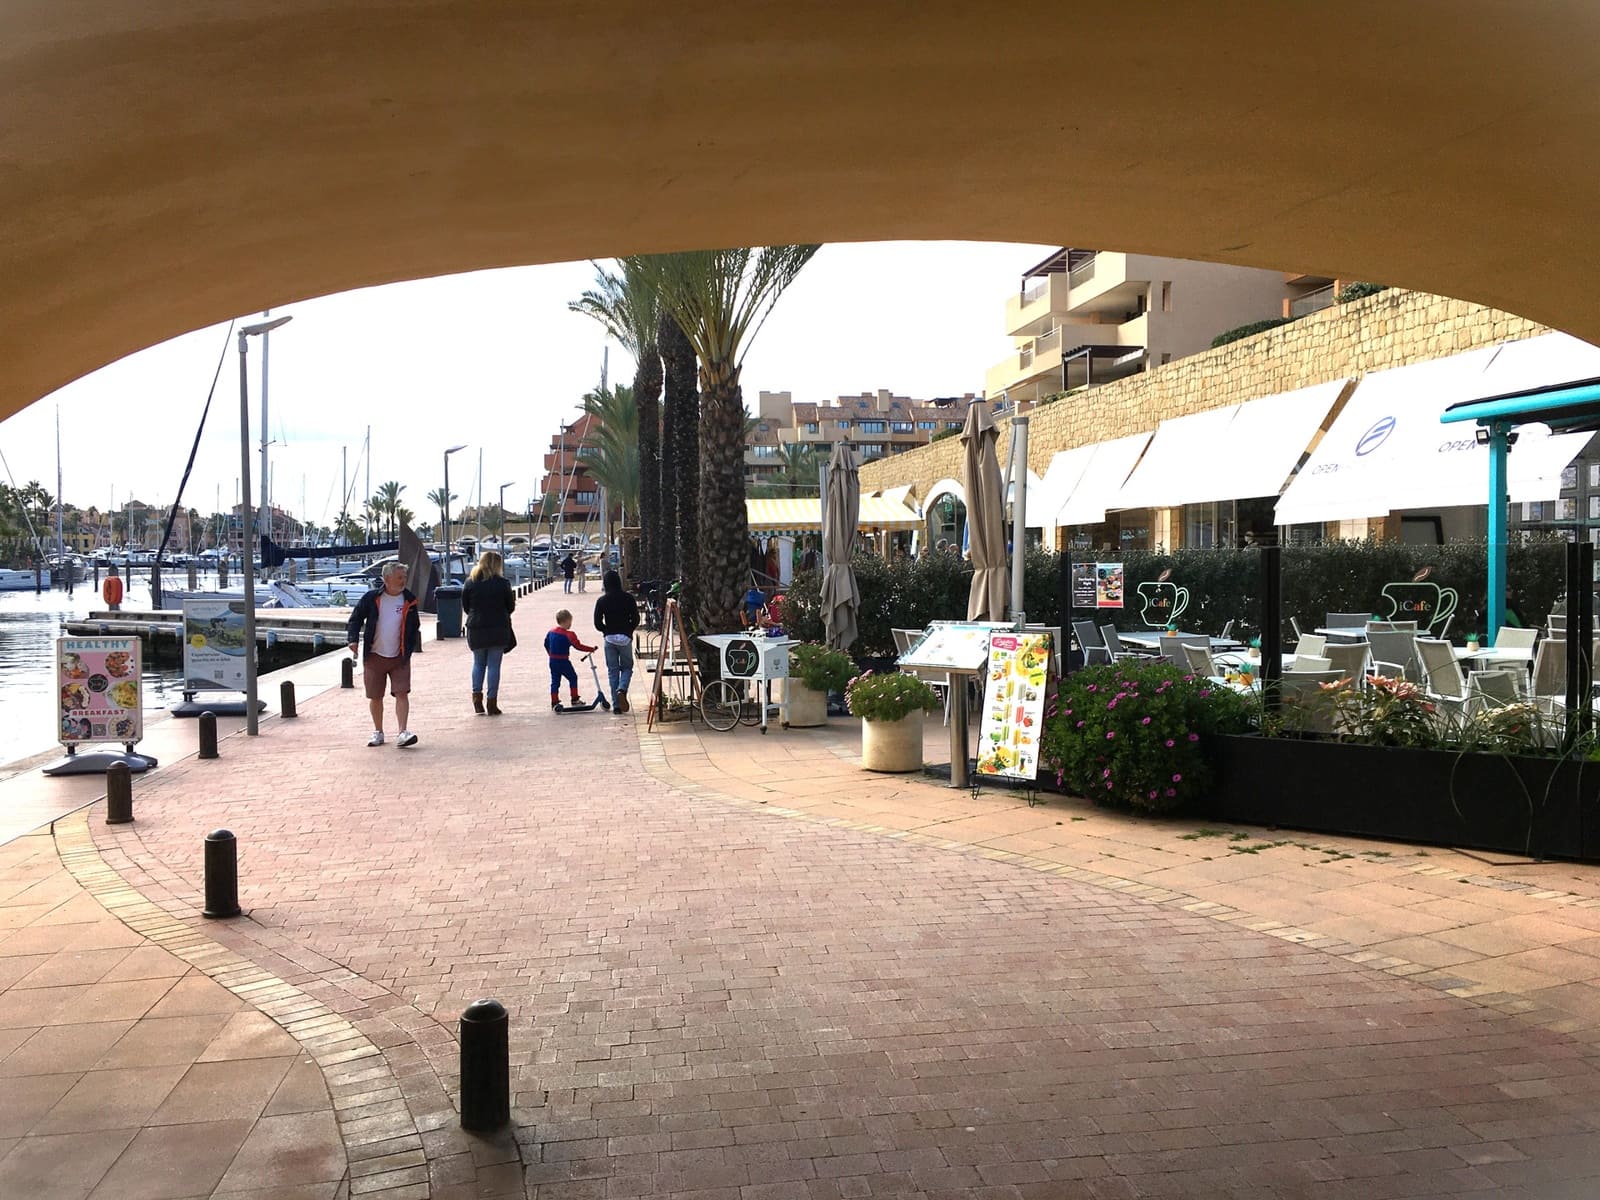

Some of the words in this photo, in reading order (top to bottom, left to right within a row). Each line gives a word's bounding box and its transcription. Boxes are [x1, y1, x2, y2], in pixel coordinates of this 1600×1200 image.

[1438, 440, 1477, 452] OPEN
[1399, 600, 1432, 611] iCafe
[66, 640, 129, 649] HEALTHY
